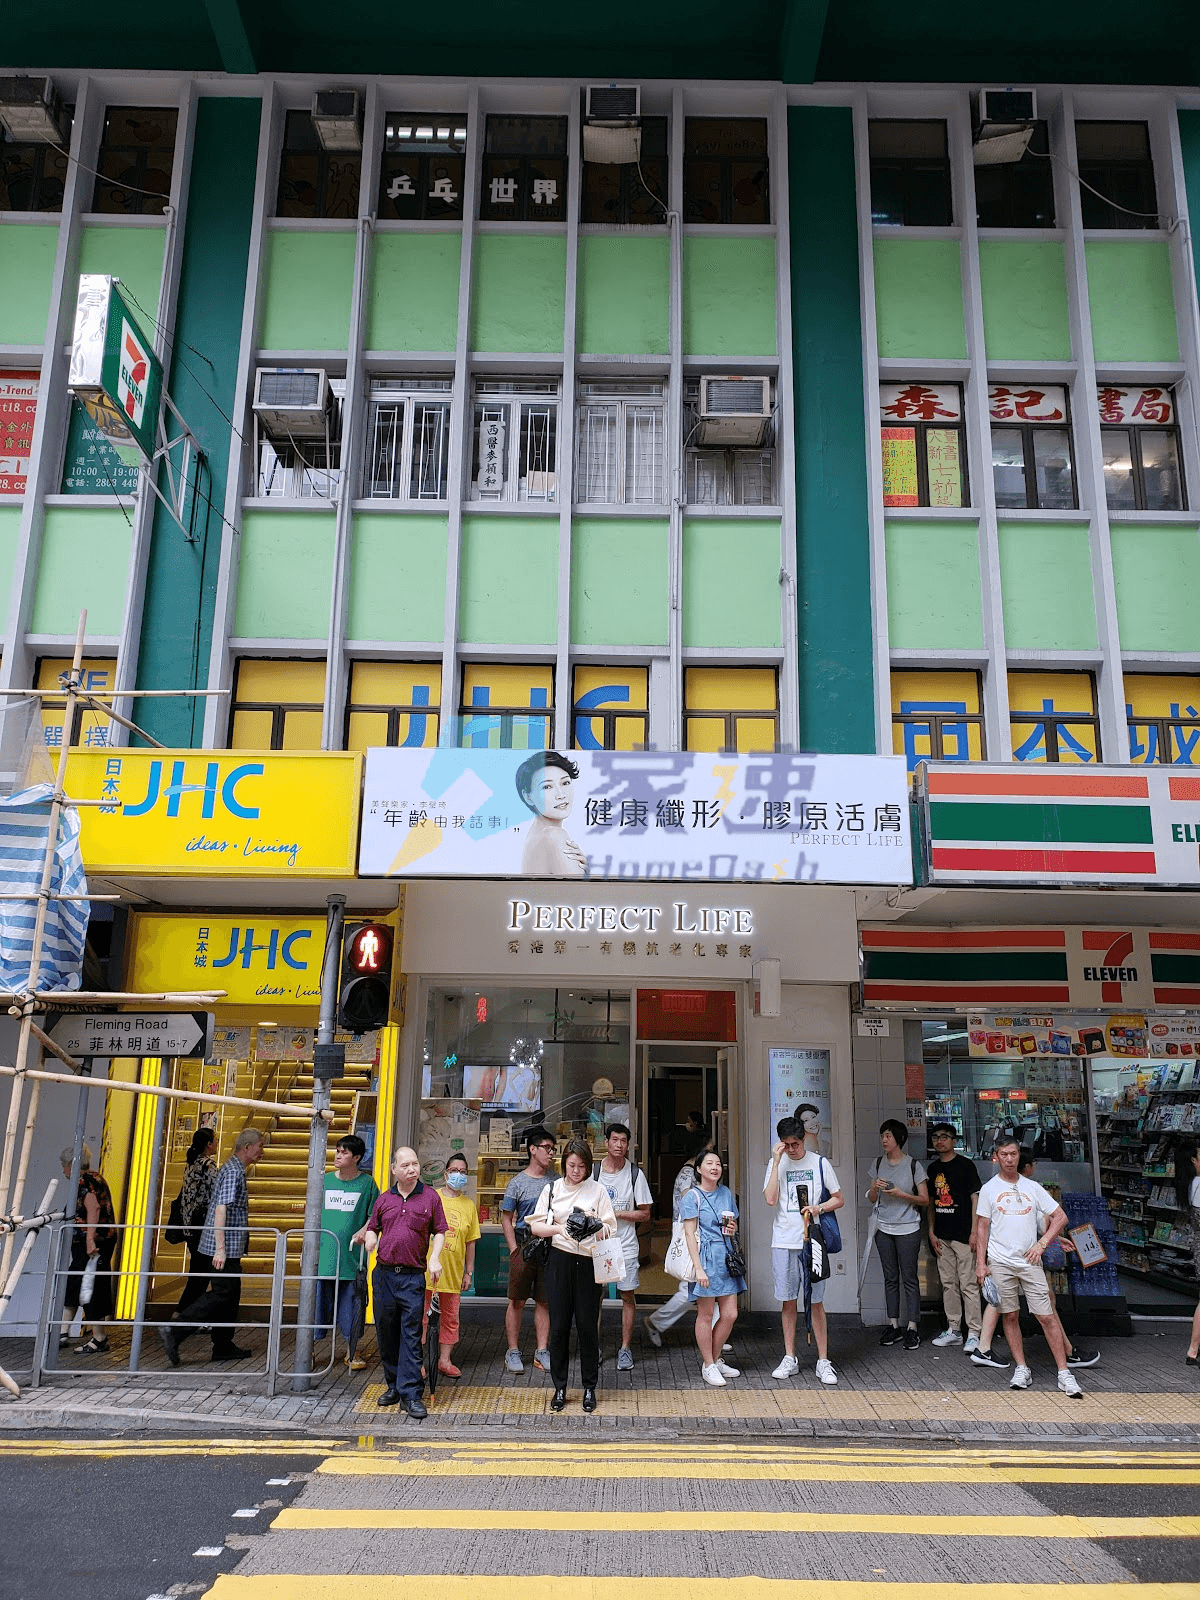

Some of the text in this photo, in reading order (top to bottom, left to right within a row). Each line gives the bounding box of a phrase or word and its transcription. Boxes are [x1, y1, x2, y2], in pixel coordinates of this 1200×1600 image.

[71, 467, 98, 476] 10:00
[122, 760, 264, 820] JHC
[507, 899, 754, 934] PERFECT LIFE
[194, 927, 209, 968] 日本城
[212, 927, 312, 970] JHC
[85, 1018, 168, 1032] Fleming Road
[870, 1028, 878, 1036] 13
[67, 1039, 80, 1049] 25
[89, 1036, 161, 1052] 菲林明道
[811, 1238, 823, 1278] NIKE
